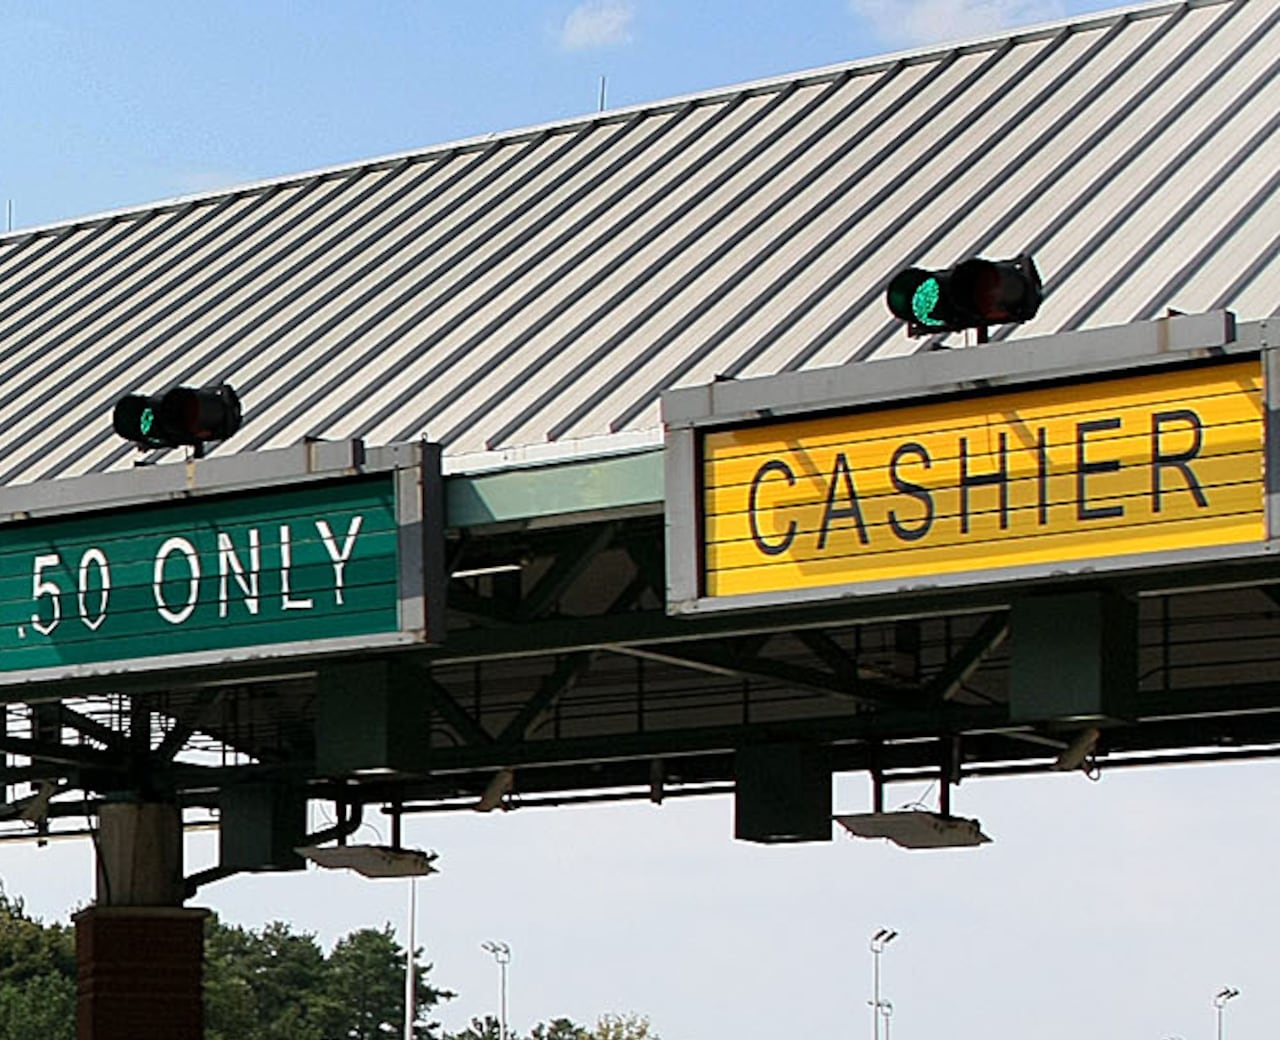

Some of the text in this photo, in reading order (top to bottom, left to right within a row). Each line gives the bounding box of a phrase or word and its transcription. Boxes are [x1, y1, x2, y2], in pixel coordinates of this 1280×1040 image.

[748, 409, 1208, 556] CASHIER
[17, 516, 363, 639] .50 ONLY
